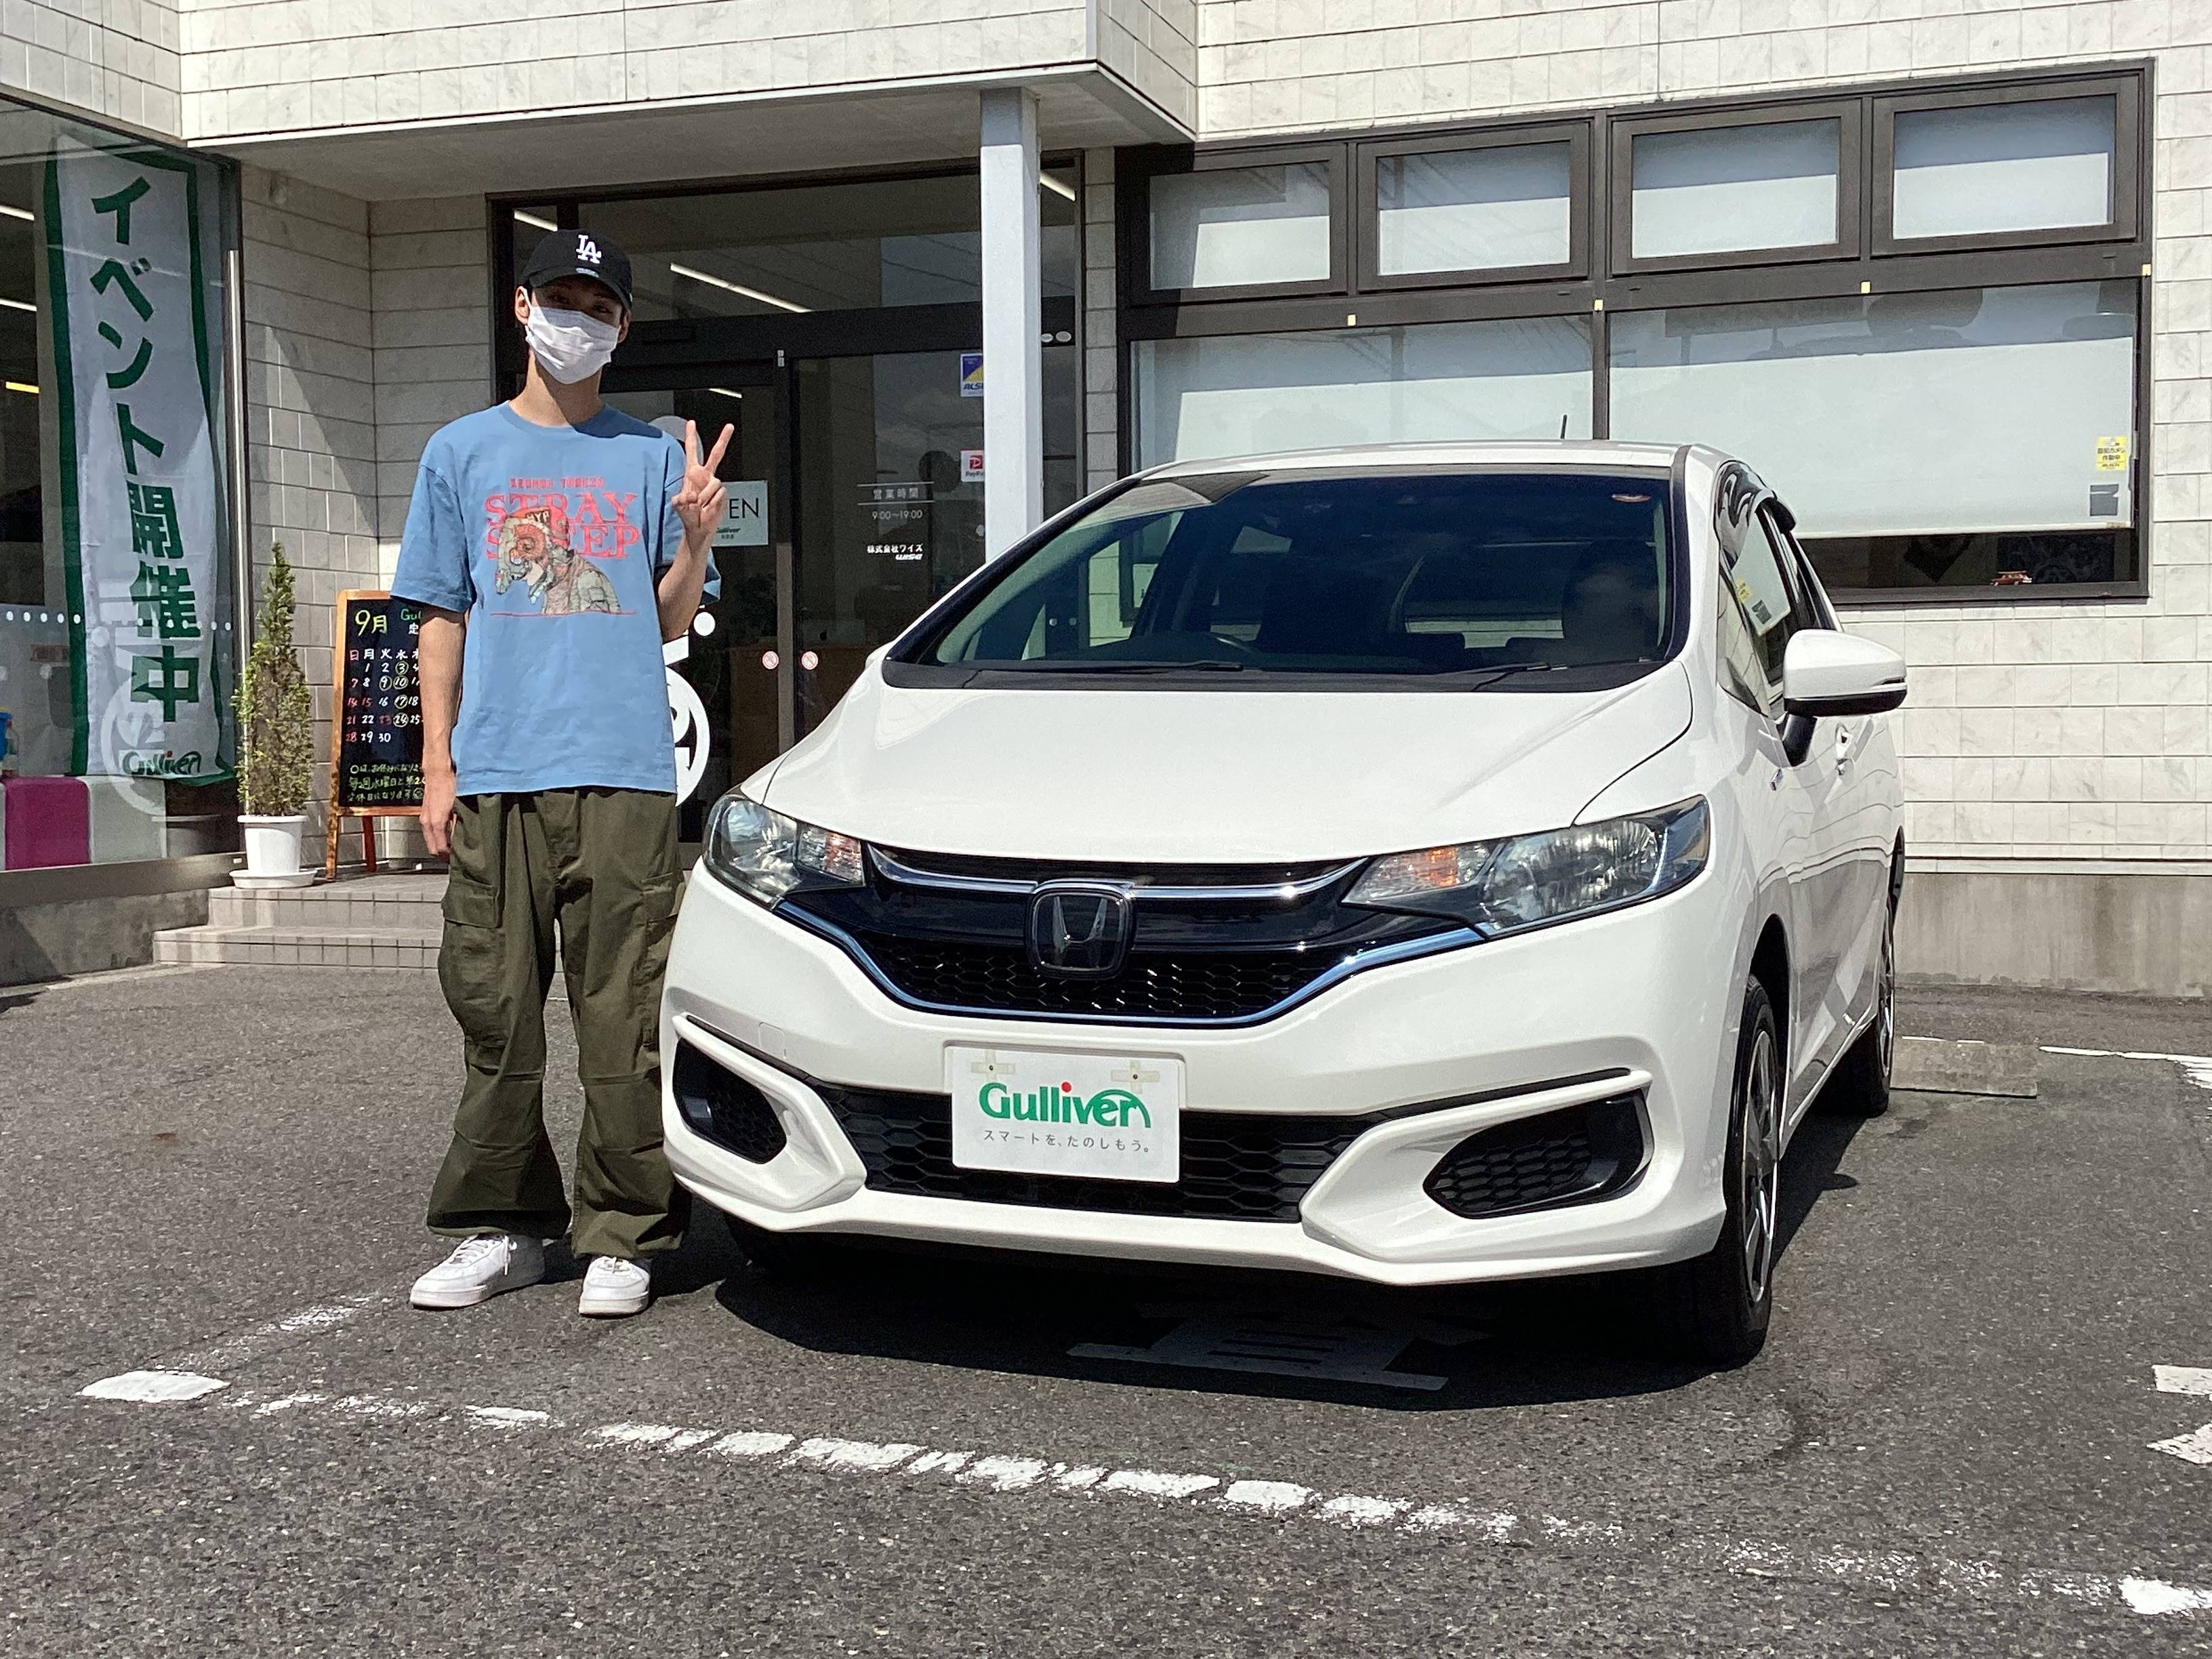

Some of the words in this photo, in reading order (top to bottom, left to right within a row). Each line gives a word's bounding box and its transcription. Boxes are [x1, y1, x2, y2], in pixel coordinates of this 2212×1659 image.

[575, 234, 602, 264] LA
[90, 176, 201, 722] イベント開催中
[484, 492, 638, 525] STRAY
[729, 497, 759, 519] EN
[354, 609, 388, 636] 9月
[350, 649, 359, 661] 日
[363, 649, 375, 660] 月
[380, 648, 393, 659] 火
[395, 649, 409, 661] 水
[381, 662, 390, 673] 2
[351, 678, 359, 688] 7
[363, 677, 371, 687] 8
[378, 696, 389, 707] 16
[408, 696, 419, 705] 18
[361, 715, 375, 724] 22
[361, 731, 374, 743] 29
[378, 733, 392, 743] 30
[122, 750, 203, 775] Gulliver
[979, 1082, 1151, 1128] Gulliver
[983, 1129, 1150, 1153] スマートを、たのしもう。
